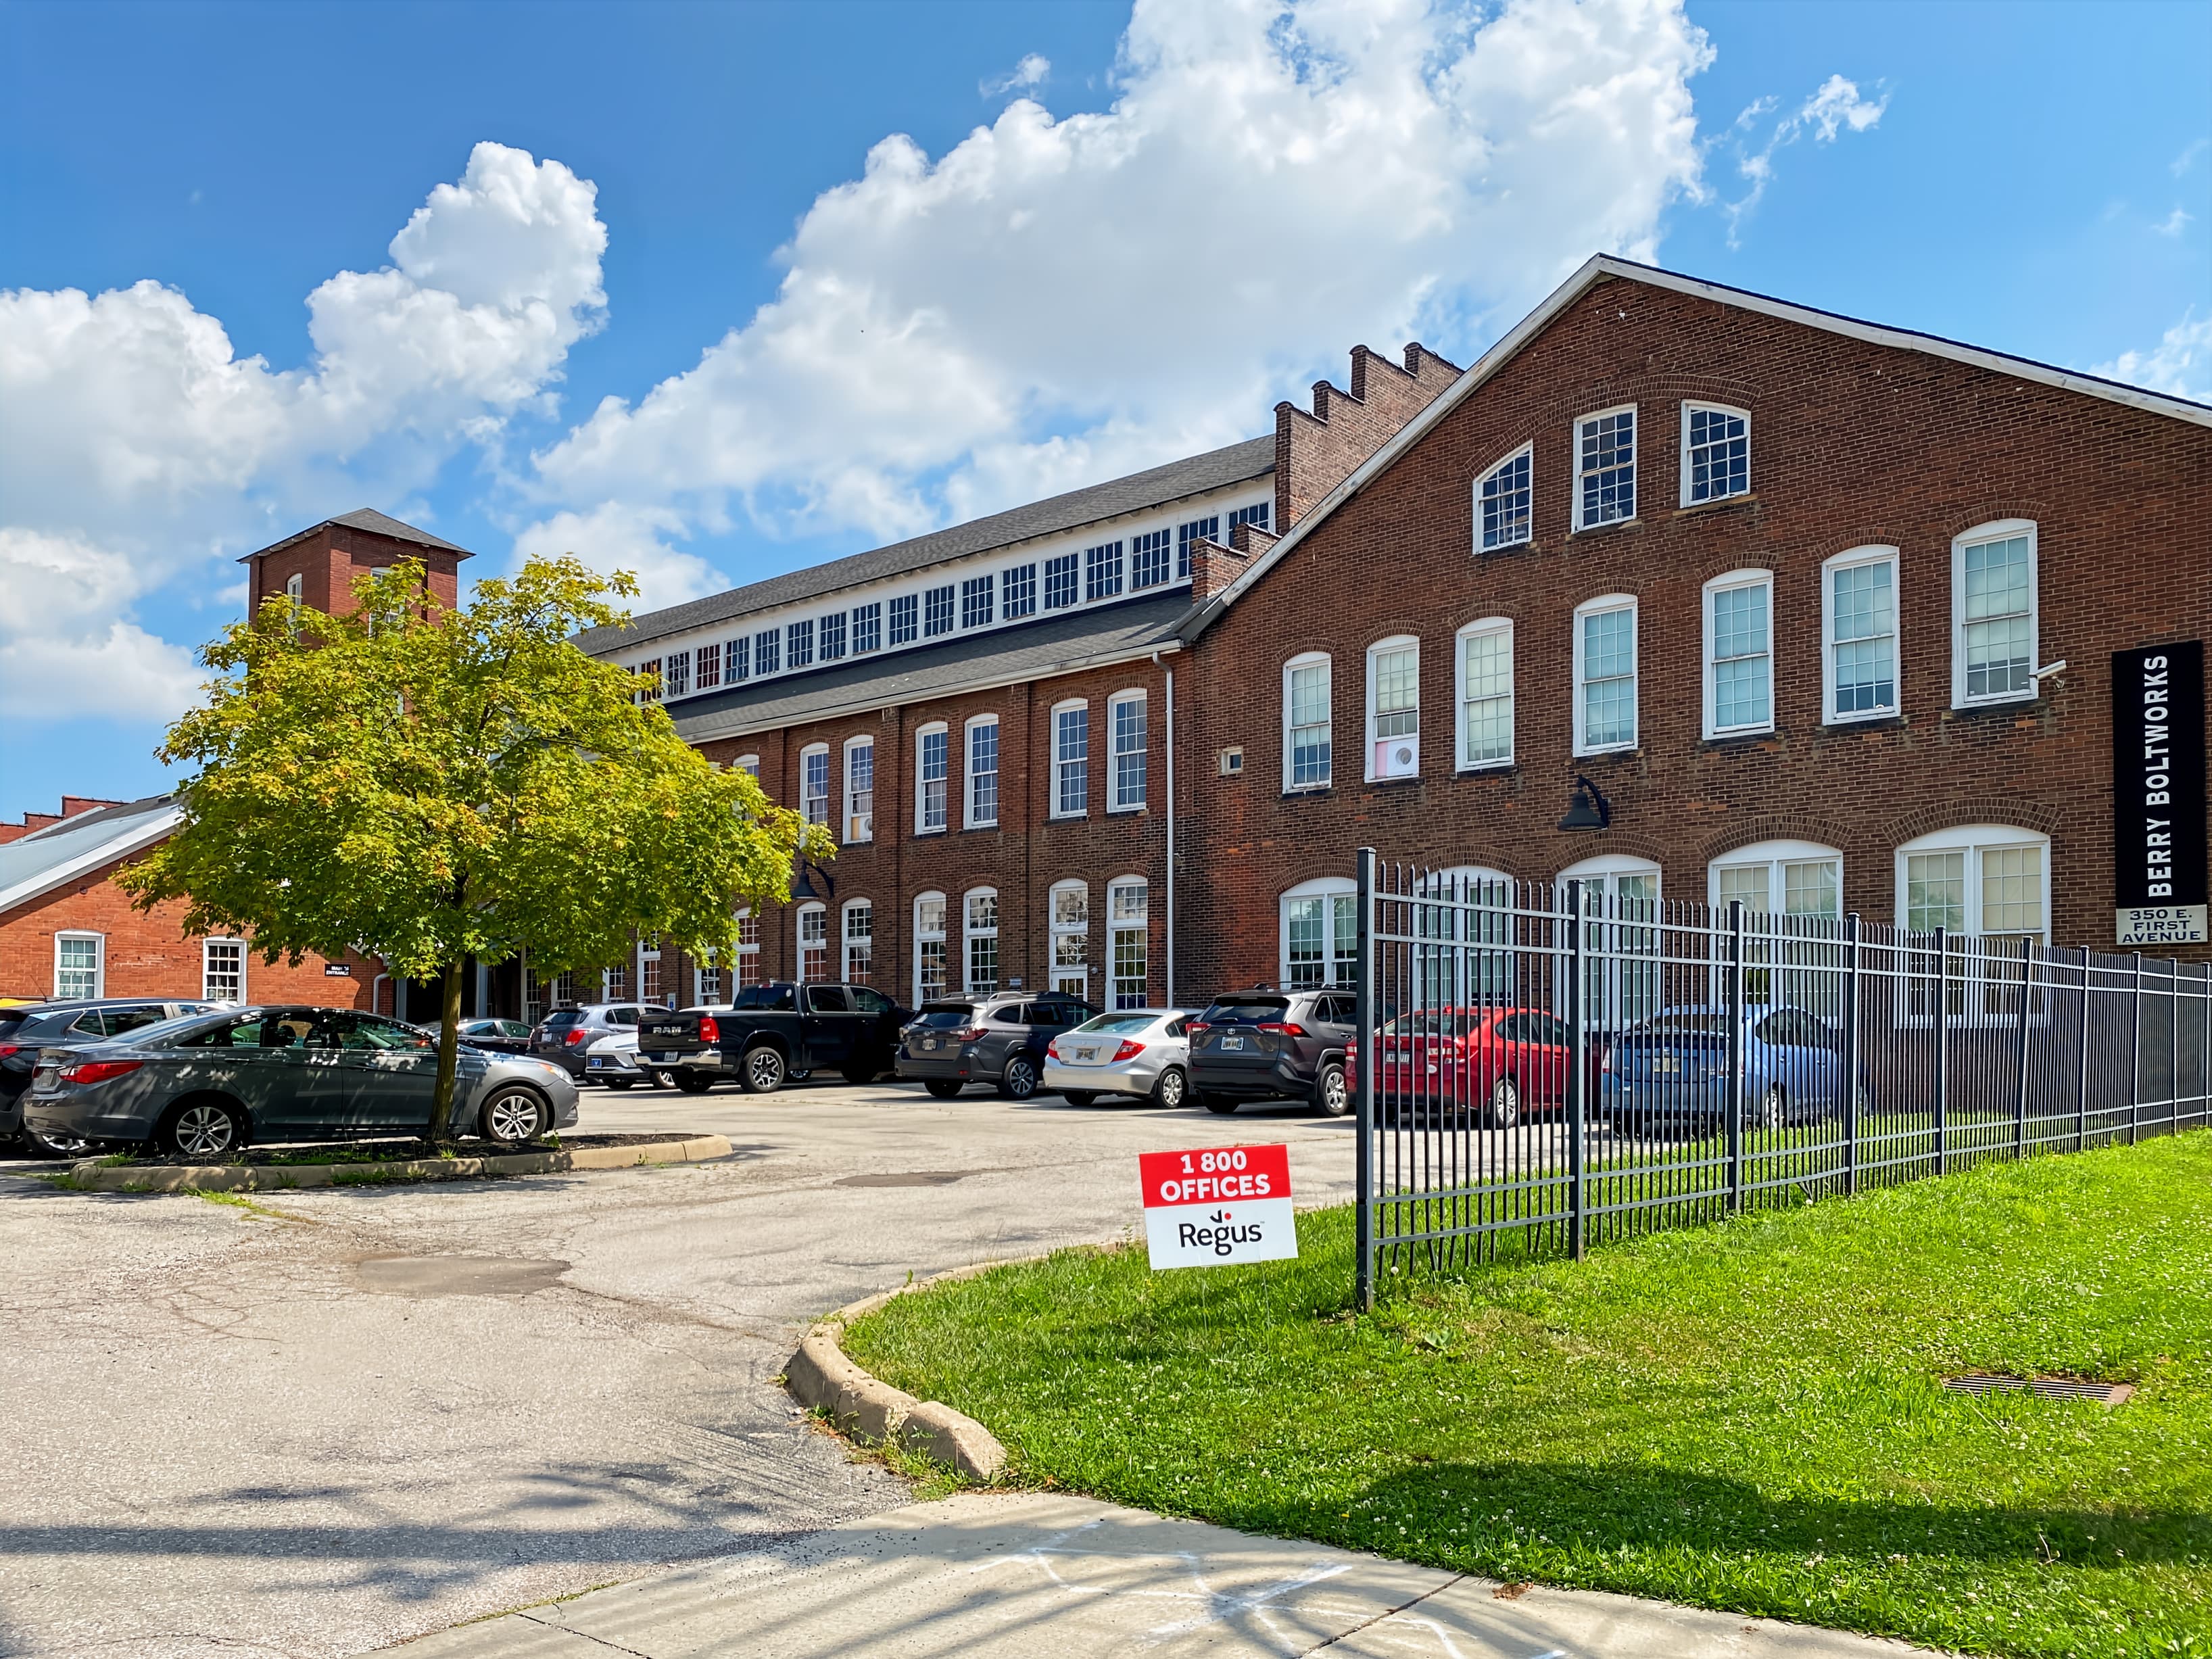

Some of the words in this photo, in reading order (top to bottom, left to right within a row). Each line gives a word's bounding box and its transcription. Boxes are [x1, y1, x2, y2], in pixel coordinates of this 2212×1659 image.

[2144, 656, 2169, 806] BOLTWORKS
[2146, 817, 2172, 897] BERRY
[2130, 909, 2168, 920] 350
[2176, 909, 2192, 918] E.
[2134, 920, 2190, 931] FIRST
[2122, 931, 2201, 943] AVENUE
[1180, 1154, 1195, 1174] 1
[1201, 1151, 1247, 1173] 800
[1160, 1174, 1271, 1201] OFFICES
[1178, 1223, 1262, 1256] Regus
